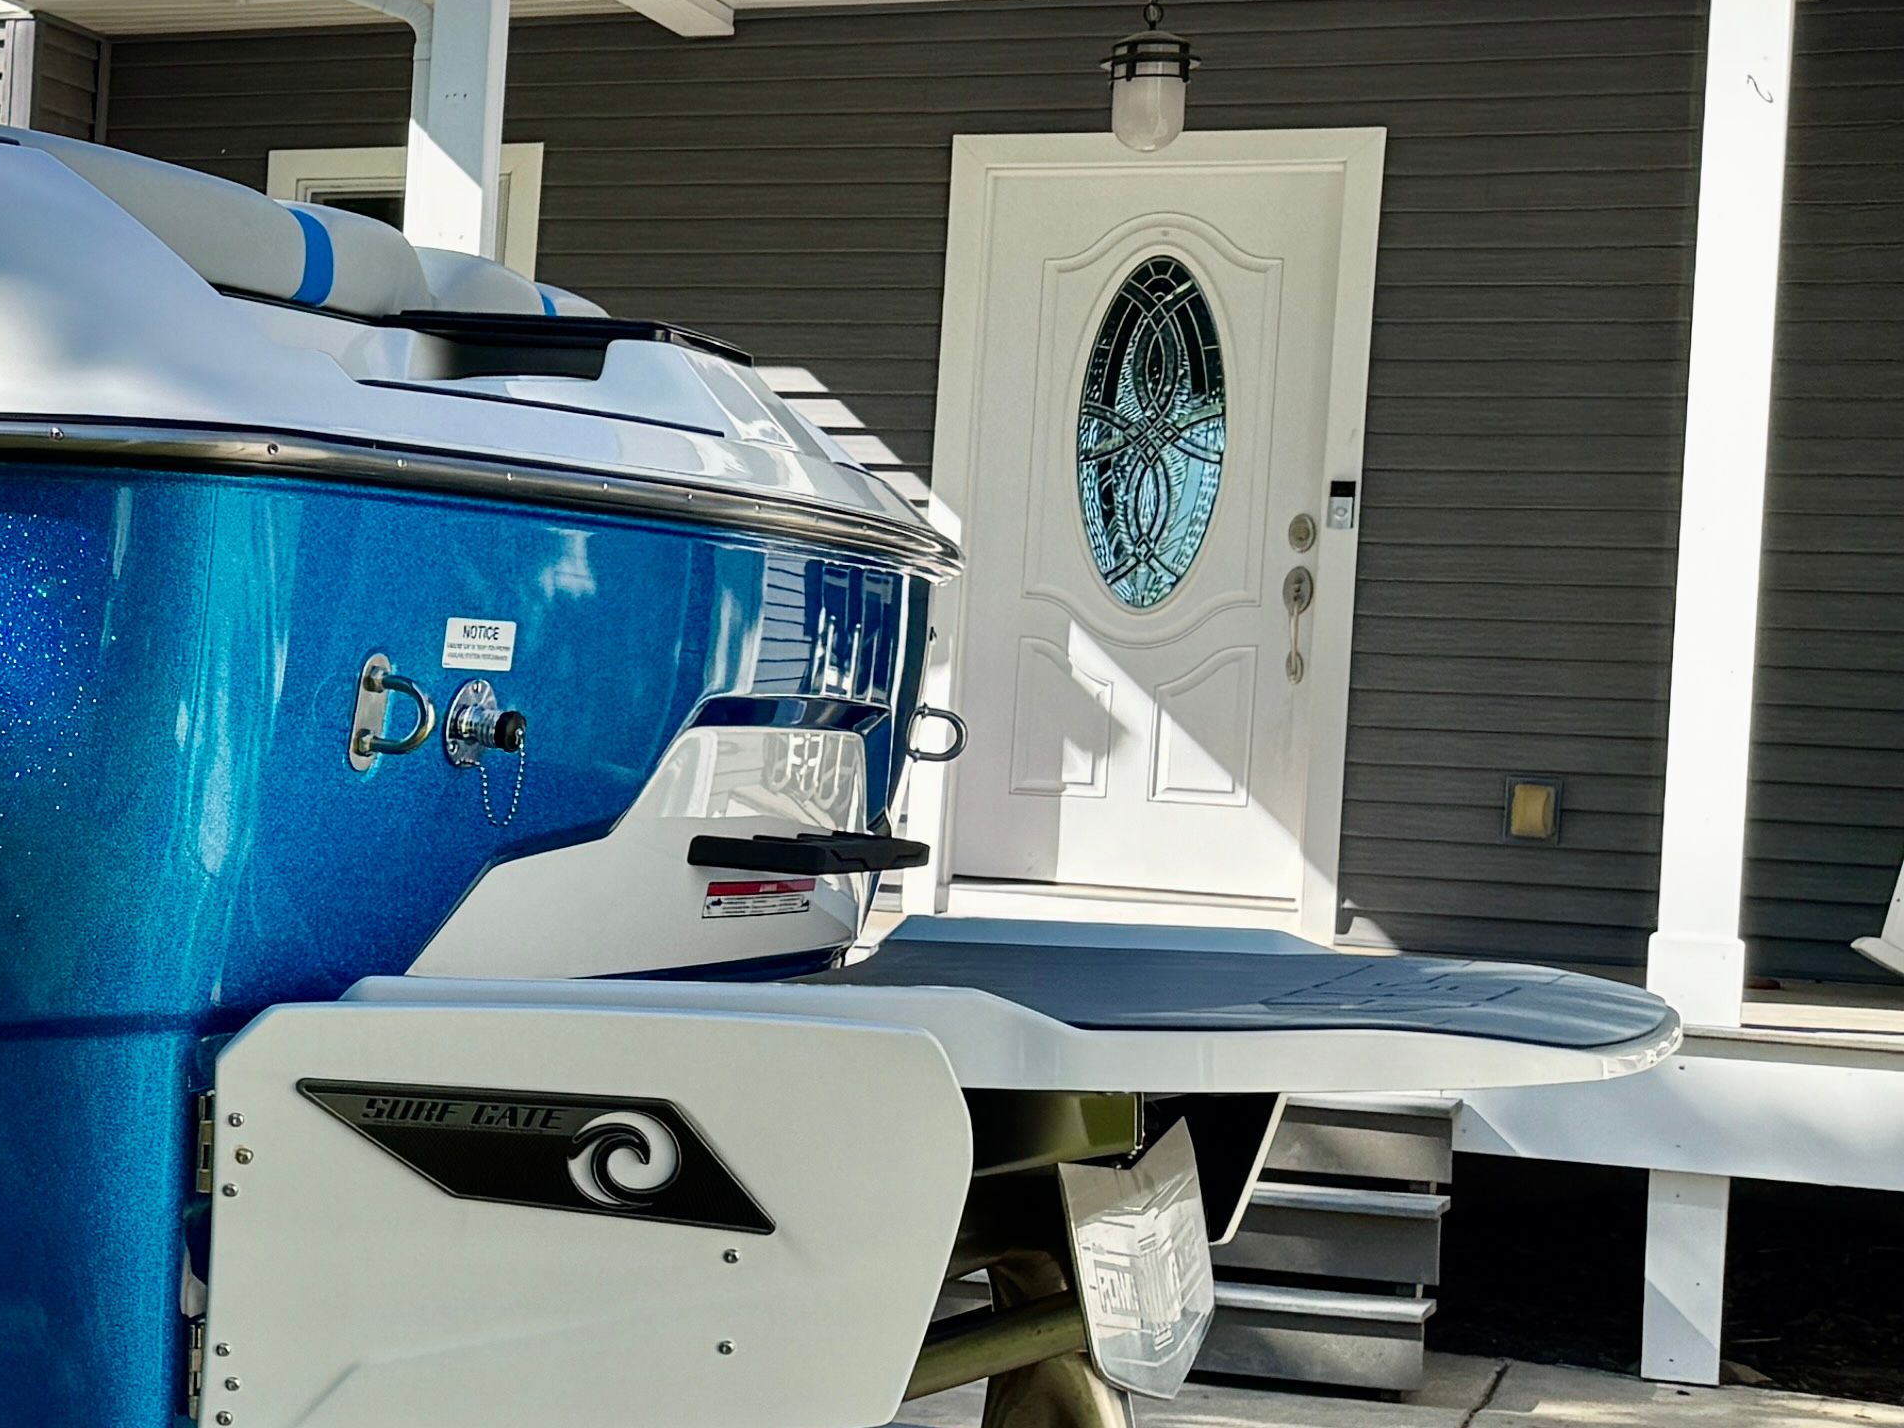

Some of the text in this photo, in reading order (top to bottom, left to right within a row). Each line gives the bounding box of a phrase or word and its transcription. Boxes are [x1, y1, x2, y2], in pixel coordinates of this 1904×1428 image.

[462, 625, 500, 641] NOTICE
[360, 1098, 569, 1130] SURF GATE
